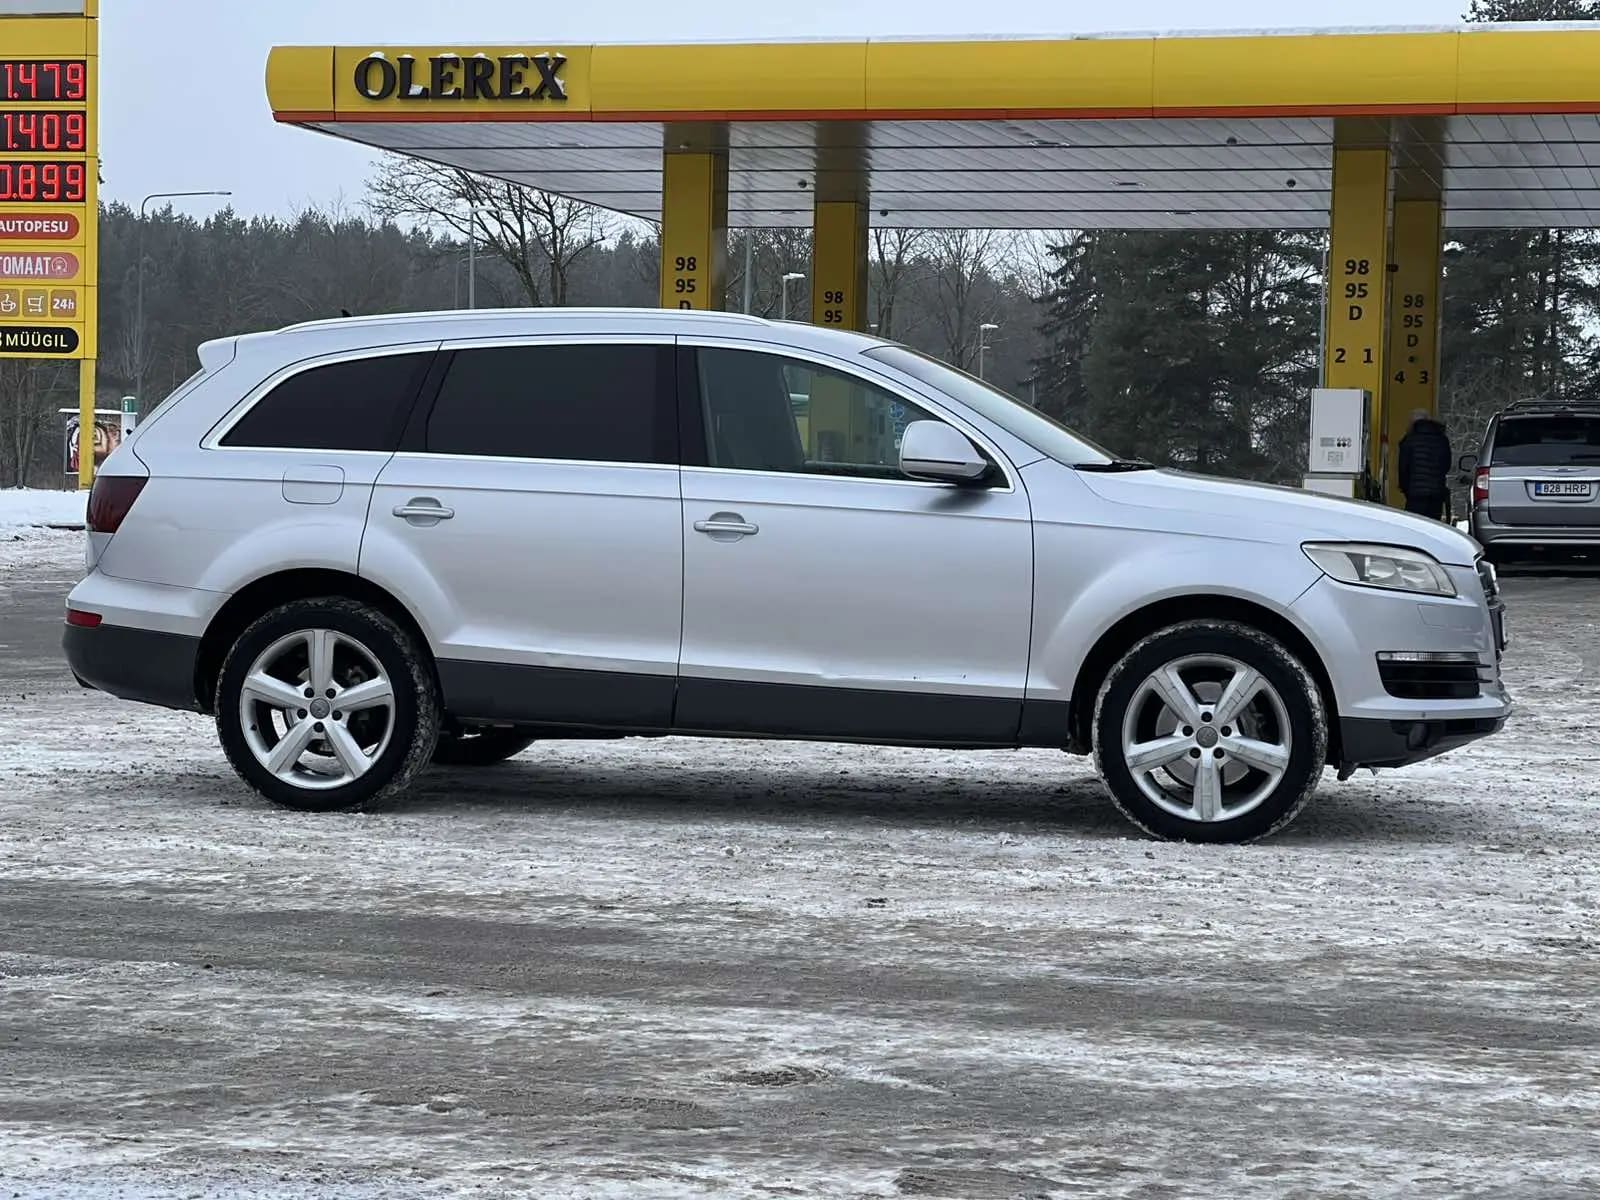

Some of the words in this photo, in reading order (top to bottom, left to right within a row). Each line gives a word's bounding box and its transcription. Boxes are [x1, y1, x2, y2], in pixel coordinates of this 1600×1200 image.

[4, 64, 84, 98] 1.479
[354, 54, 568, 100] OLEREX
[4, 114, 84, 149] 1.409
[675, 257, 697, 271] 98
[1345, 260, 1369, 275] 98
[675, 279, 696, 293] 95
[1345, 283, 1368, 298] 95
[53, 298, 75, 310] 24h
[824, 291, 844, 304] 98
[1403, 295, 1424, 308] 98
[824, 310, 843, 323] 95
[1349, 305, 1363, 321] D
[1403, 315, 1423, 328] 95
[6, 331, 68, 347] MÜÜGIL
[1407, 334, 1418, 347] D
[1335, 348, 1346, 363] 2
[1363, 348, 1374, 363] 1
[1395, 371, 1406, 384] 4
[1419, 371, 1429, 384] 3
[1564, 484, 1587, 493] HRP
